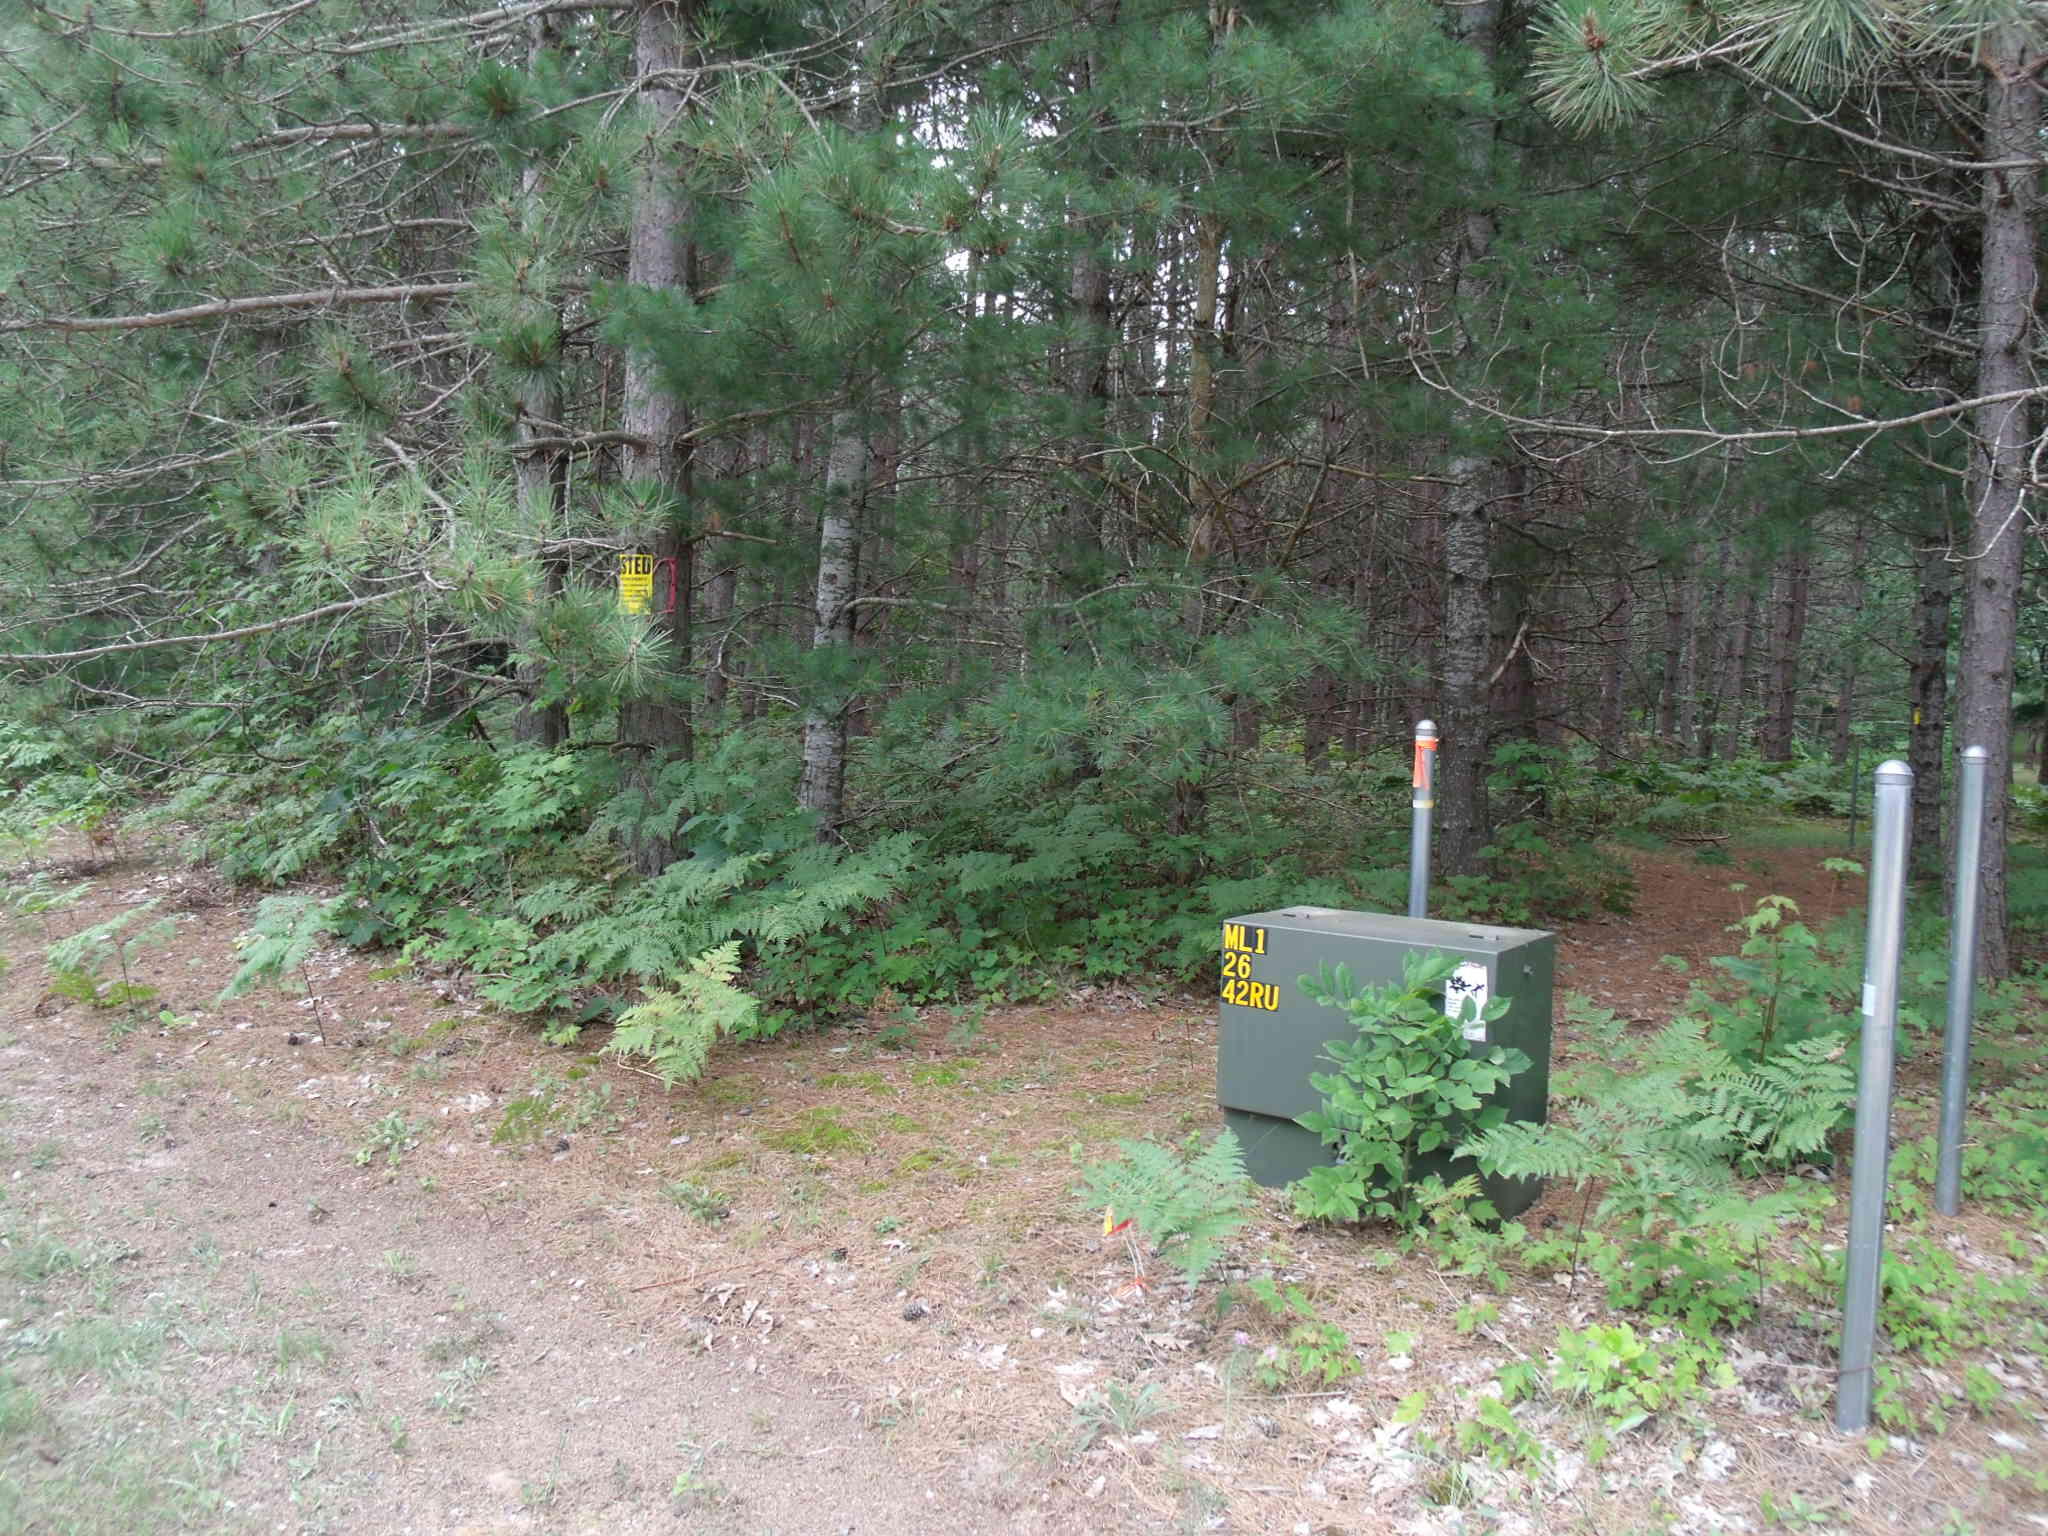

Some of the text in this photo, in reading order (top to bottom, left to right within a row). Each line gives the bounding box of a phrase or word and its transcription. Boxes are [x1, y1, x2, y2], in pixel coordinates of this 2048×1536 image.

[621, 556, 651, 575] STED
[1222, 951, 1251, 979] 26
[1221, 979, 1280, 1011] 42RU
